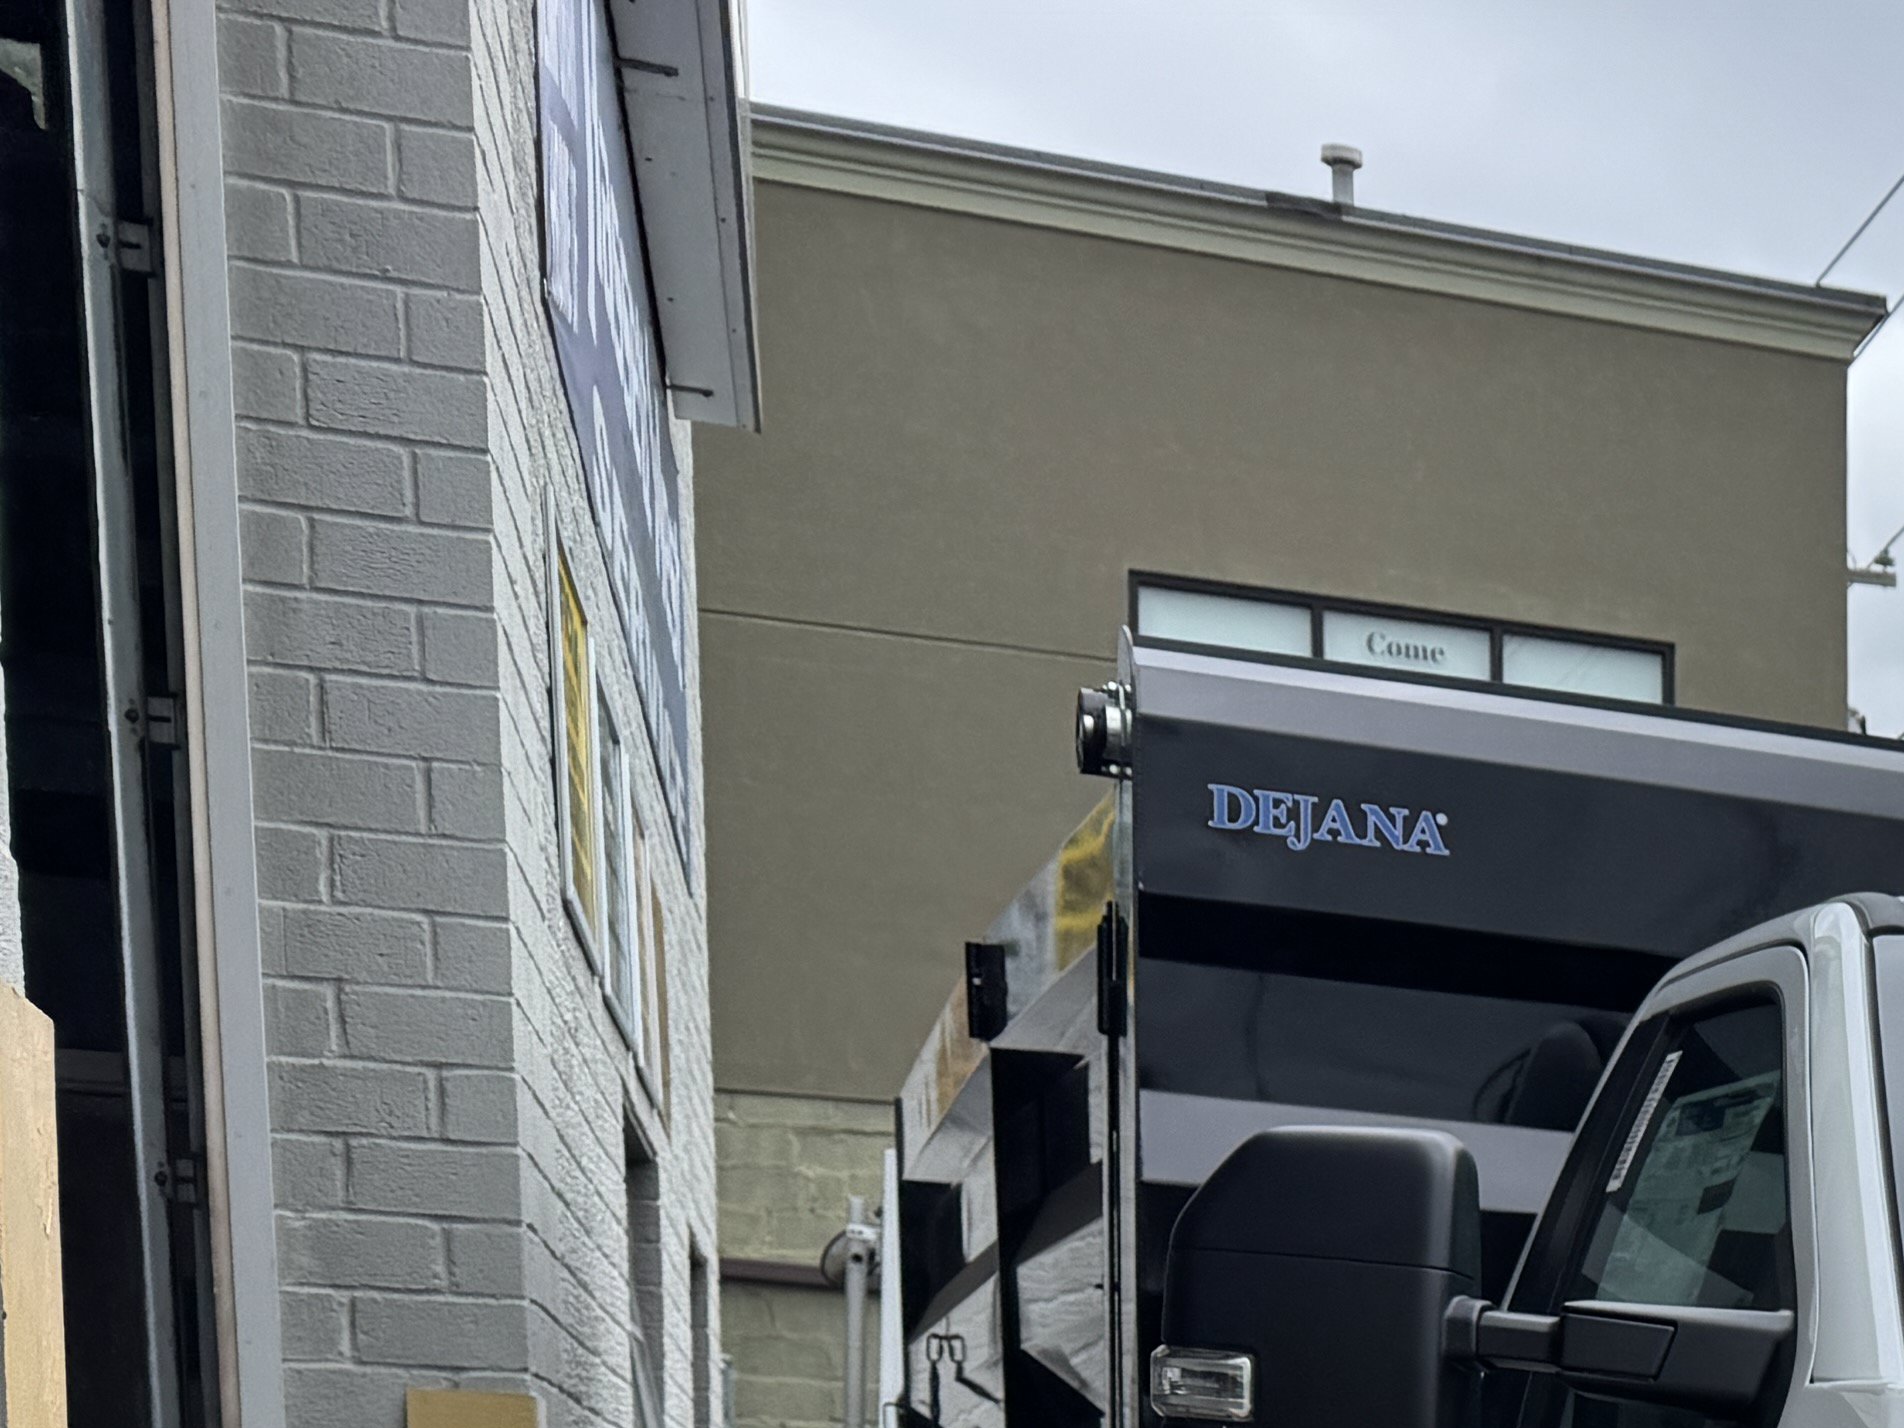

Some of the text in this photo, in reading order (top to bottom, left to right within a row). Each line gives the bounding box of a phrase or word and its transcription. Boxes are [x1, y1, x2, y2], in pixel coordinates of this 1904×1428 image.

[593, 385, 687, 864] SERVICE
[1366, 631, 1445, 664] Come
[1207, 783, 1450, 856] DEJANA
